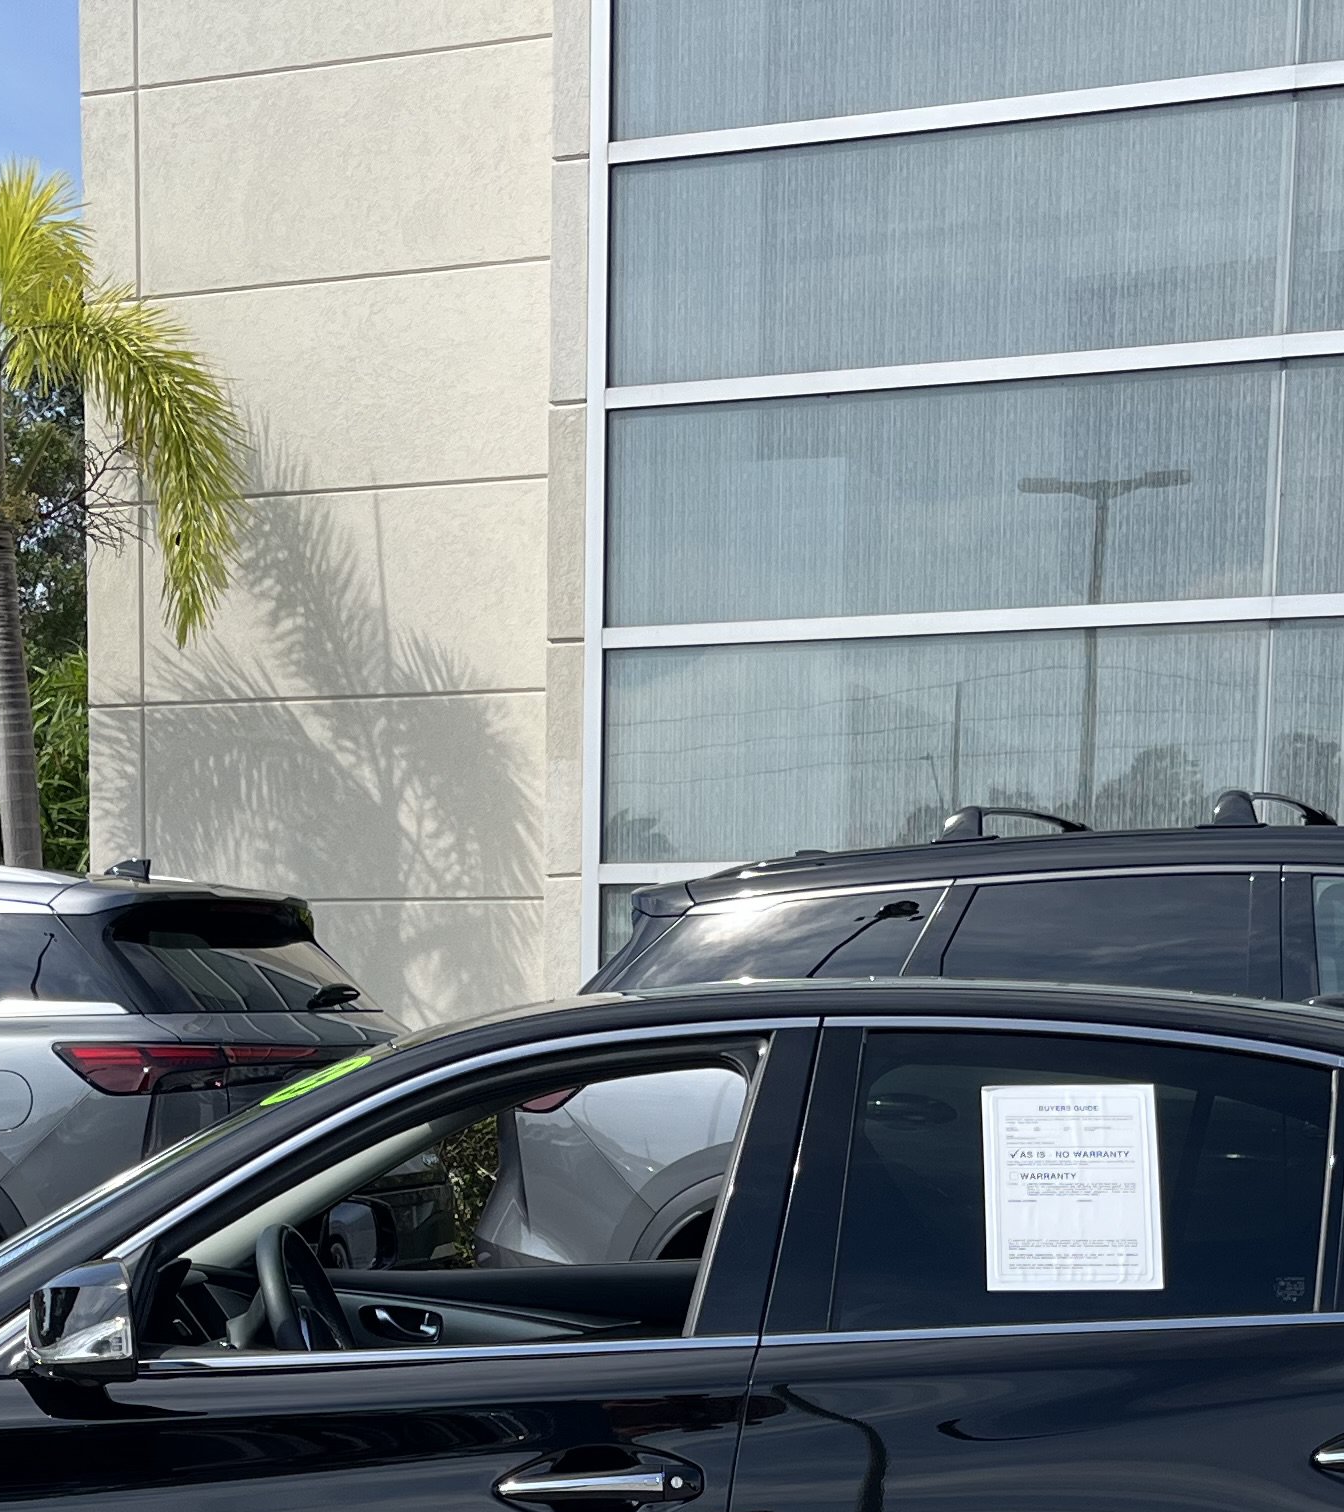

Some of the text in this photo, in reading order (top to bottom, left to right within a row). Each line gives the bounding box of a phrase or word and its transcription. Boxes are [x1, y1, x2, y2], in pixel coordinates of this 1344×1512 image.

[1020, 1150, 1033, 1159] AS
[1036, 1150, 1046, 1159] IS
[1055, 1150, 1070, 1159] NO
[1073, 1150, 1130, 1159] WARRANTY
[1020, 1172, 1077, 1180] WARRANTY
